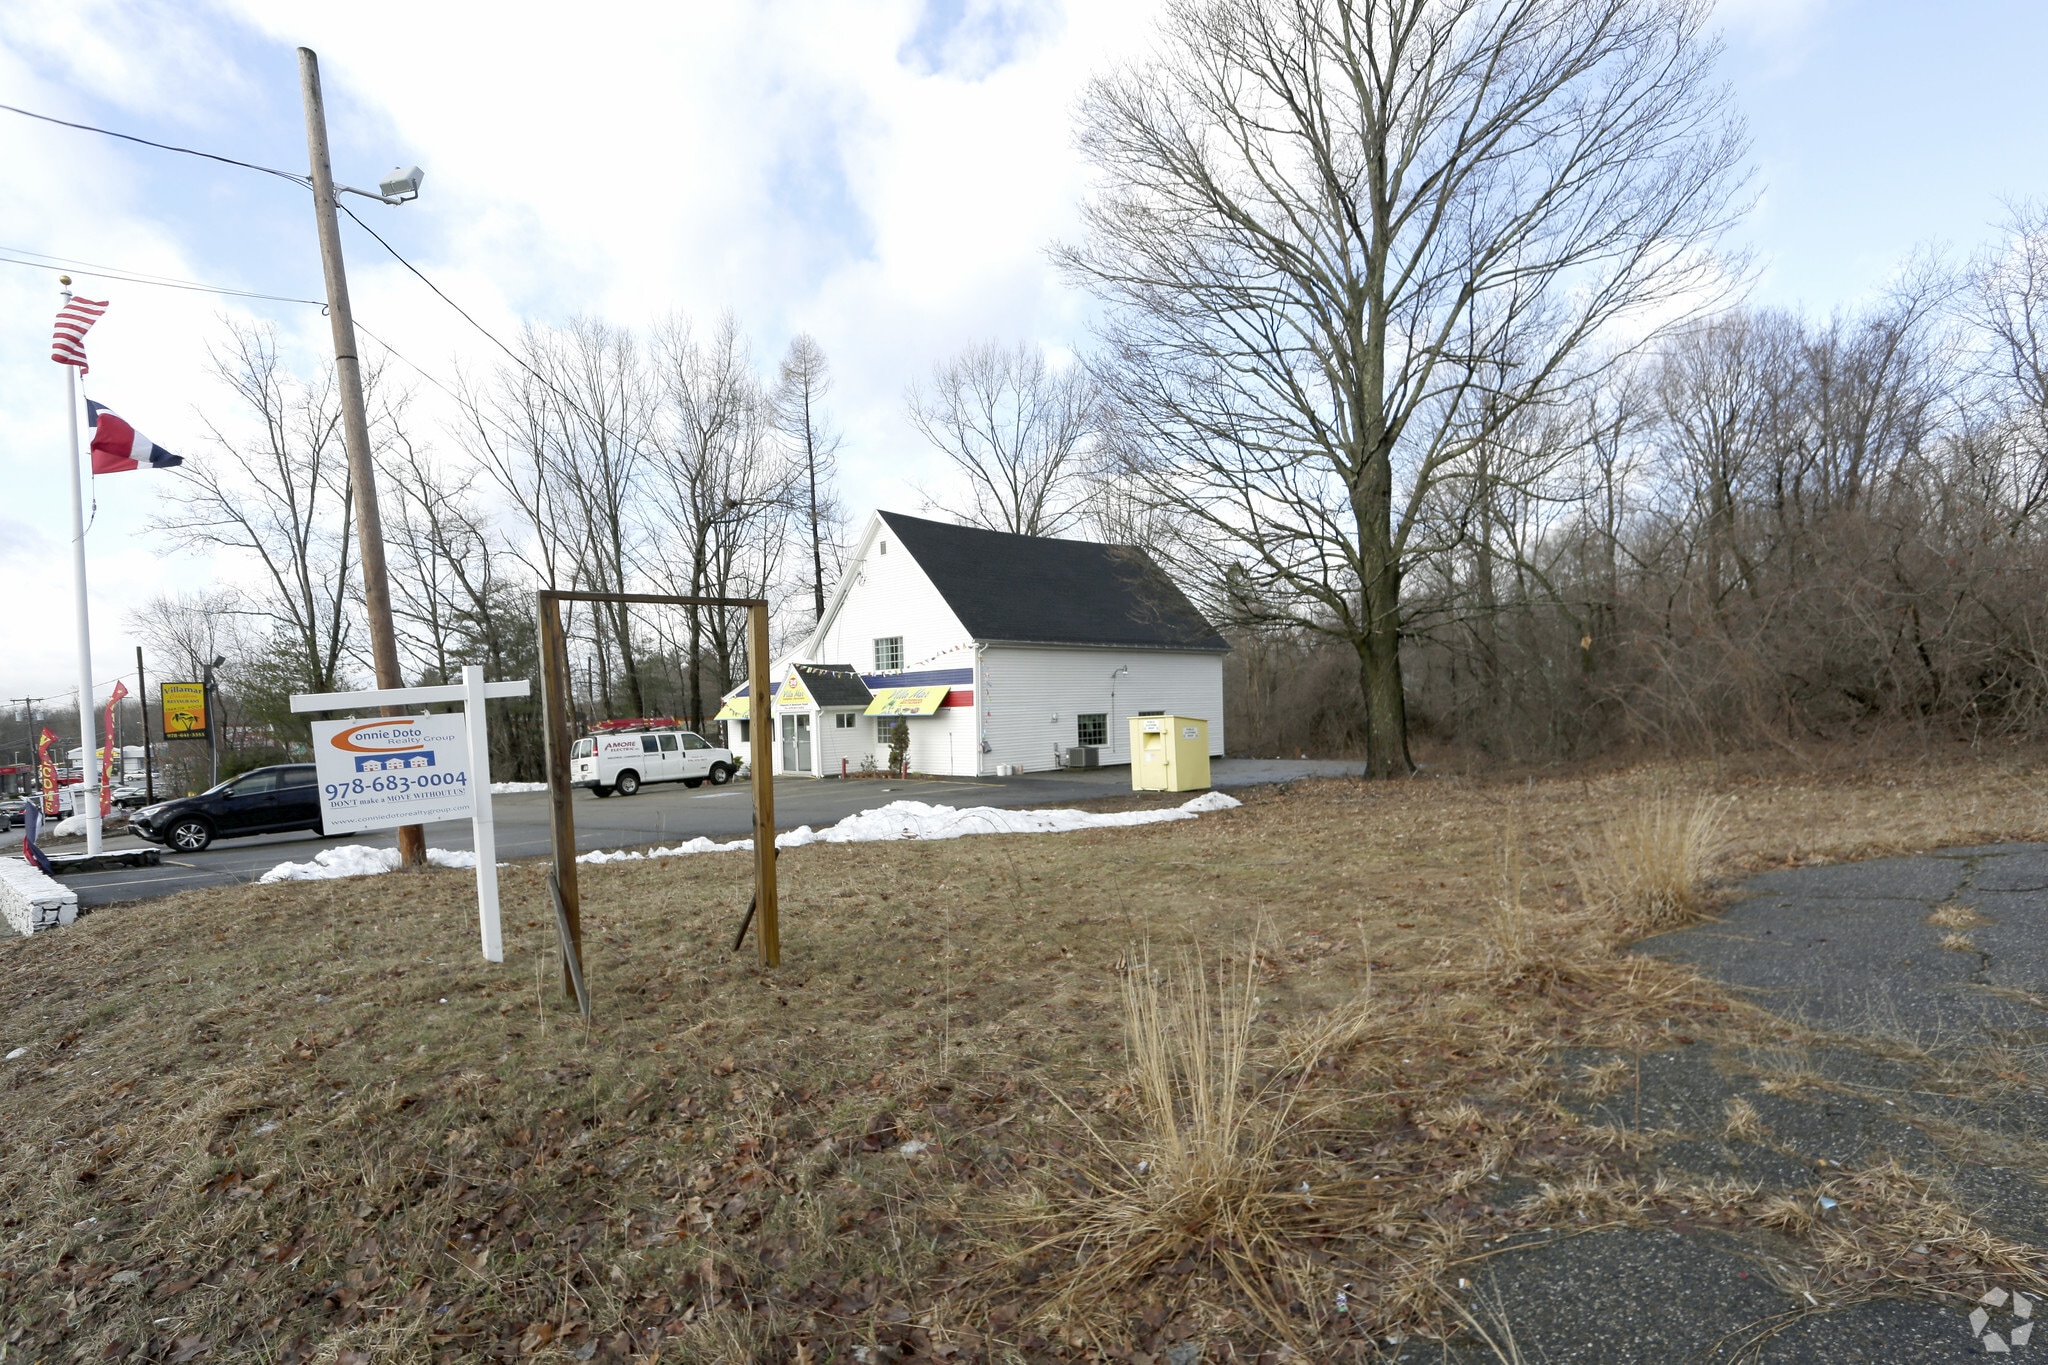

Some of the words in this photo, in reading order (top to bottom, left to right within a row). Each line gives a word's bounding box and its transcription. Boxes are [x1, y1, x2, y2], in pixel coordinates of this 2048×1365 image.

[164, 686, 202, 694] Villamar
[392, 728, 422, 738] Doto
[388, 736, 420, 745] Realty
[423, 734, 455, 742] Group
[604, 741, 636, 751] AMORE
[324, 771, 467, 801] 978-683-0004
[330, 799, 358, 808] DON'T
[359, 798, 380, 806] make
[387, 794, 411, 802] MOVE
[414, 790, 451, 799] WITHOUT
[452, 787, 466, 795] US!
[330, 804, 470, 825] www.conniedotorealtygroup.com
